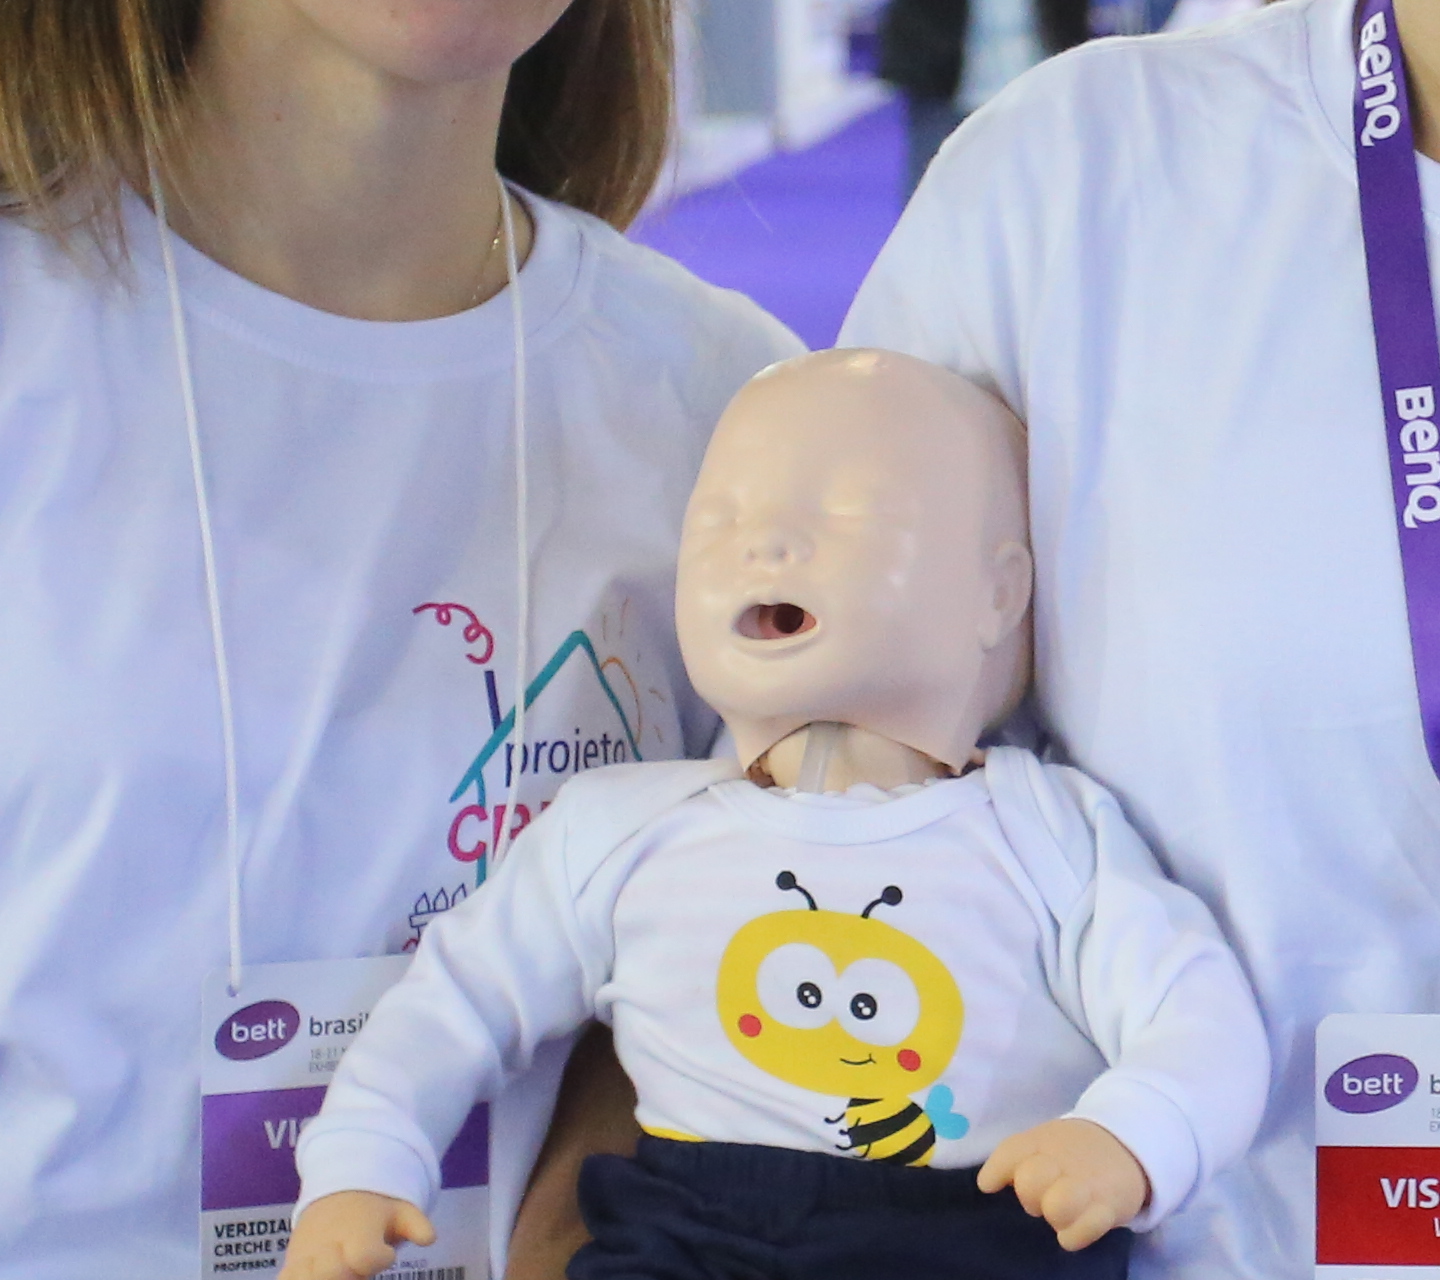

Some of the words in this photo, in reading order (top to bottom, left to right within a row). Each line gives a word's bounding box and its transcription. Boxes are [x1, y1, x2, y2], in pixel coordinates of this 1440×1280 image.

[1358, 12, 1401, 147] BenQ
[506, 728, 626, 788] projeto
[231, 1018, 287, 1043] bett
[1342, 1072, 1404, 1095] bett
[214, 1239, 271, 1256] CRECHE
